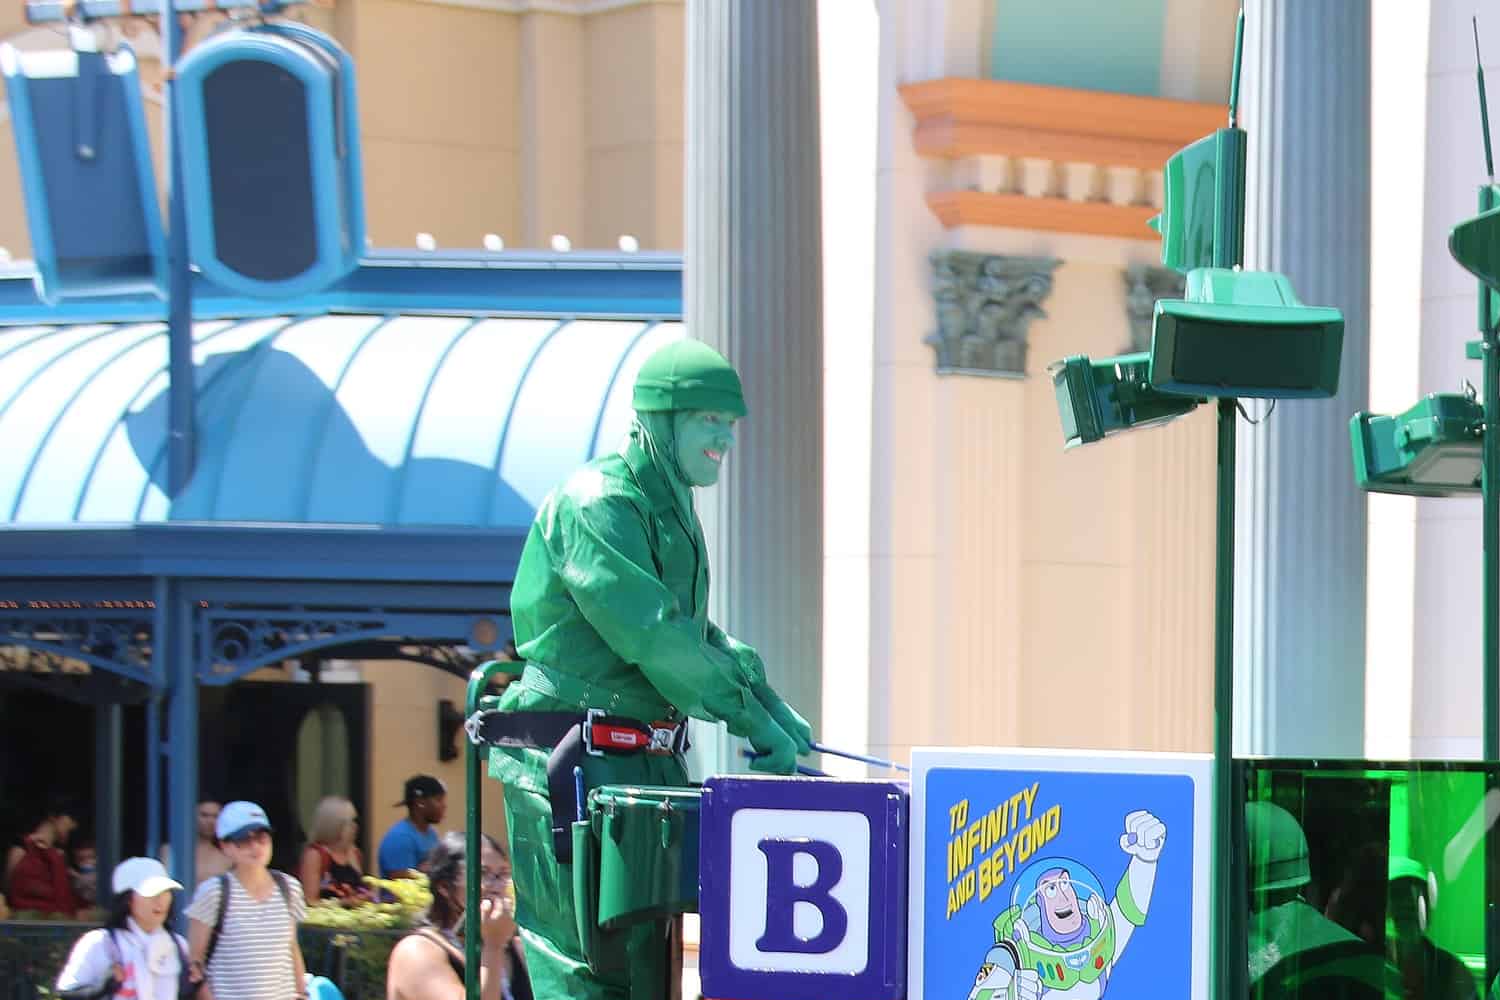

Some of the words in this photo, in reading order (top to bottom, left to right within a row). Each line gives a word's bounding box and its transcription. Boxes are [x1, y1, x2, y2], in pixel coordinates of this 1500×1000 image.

[946, 870, 976, 921] AND
[979, 804, 1062, 902] BEYOND
[947, 782, 1039, 884] INFINITY
[949, 799, 969, 836] TO
[755, 838, 848, 954] B
